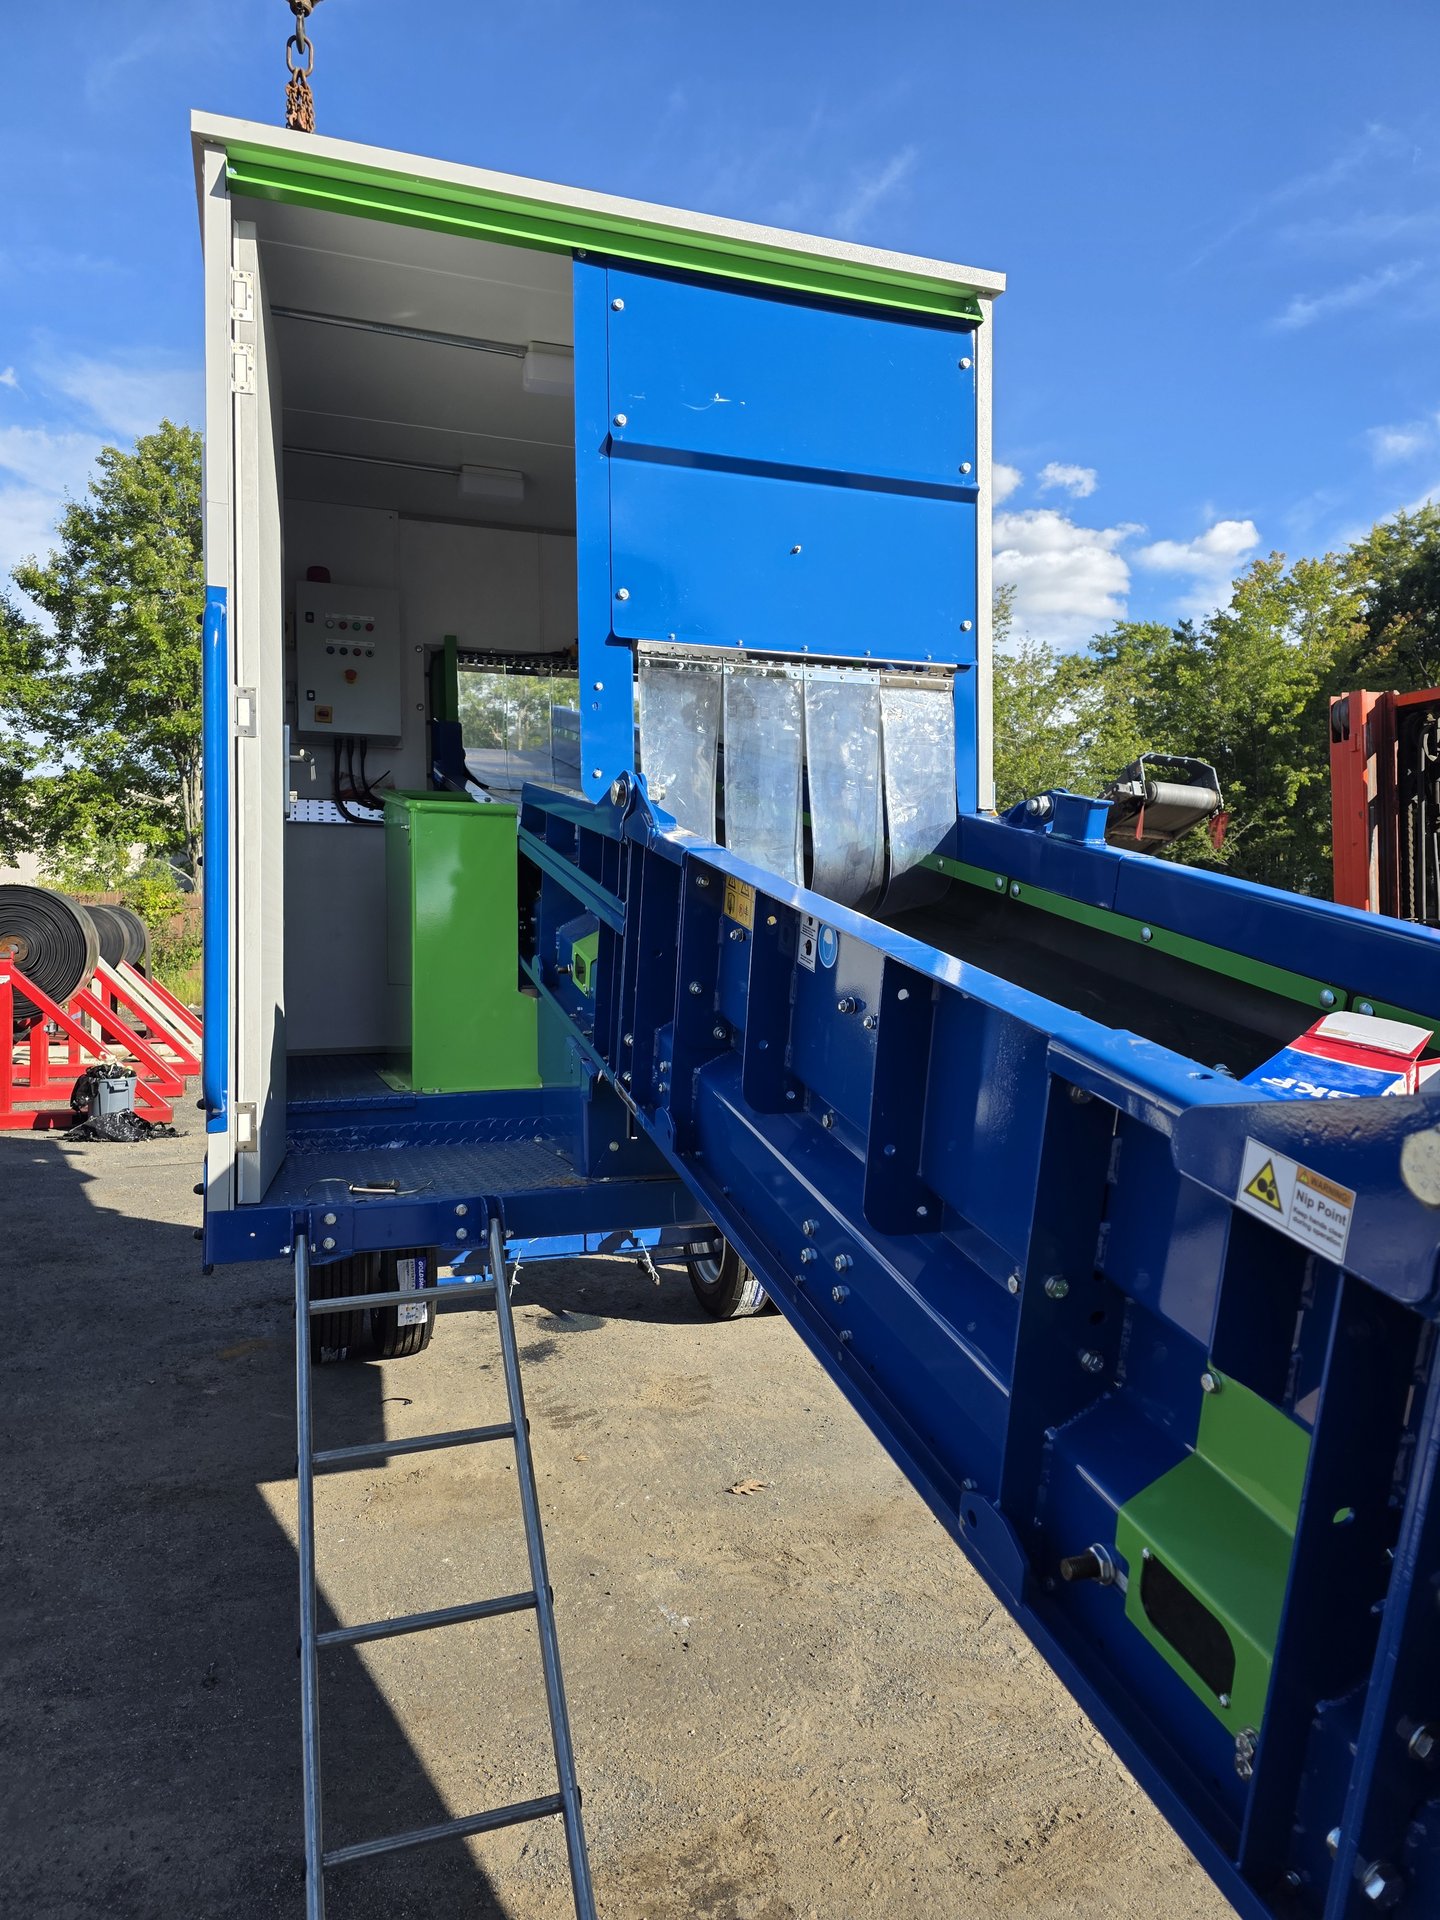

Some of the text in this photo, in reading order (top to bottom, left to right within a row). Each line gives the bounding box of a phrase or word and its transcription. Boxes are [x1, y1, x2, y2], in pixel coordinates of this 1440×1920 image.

[1260, 1077, 1361, 1099] SKF
[1293, 1206, 1345, 1239] Keep hands clear
[1296, 1189, 1347, 1226] Nip Point
[1292, 1216, 1342, 1247] during operation
